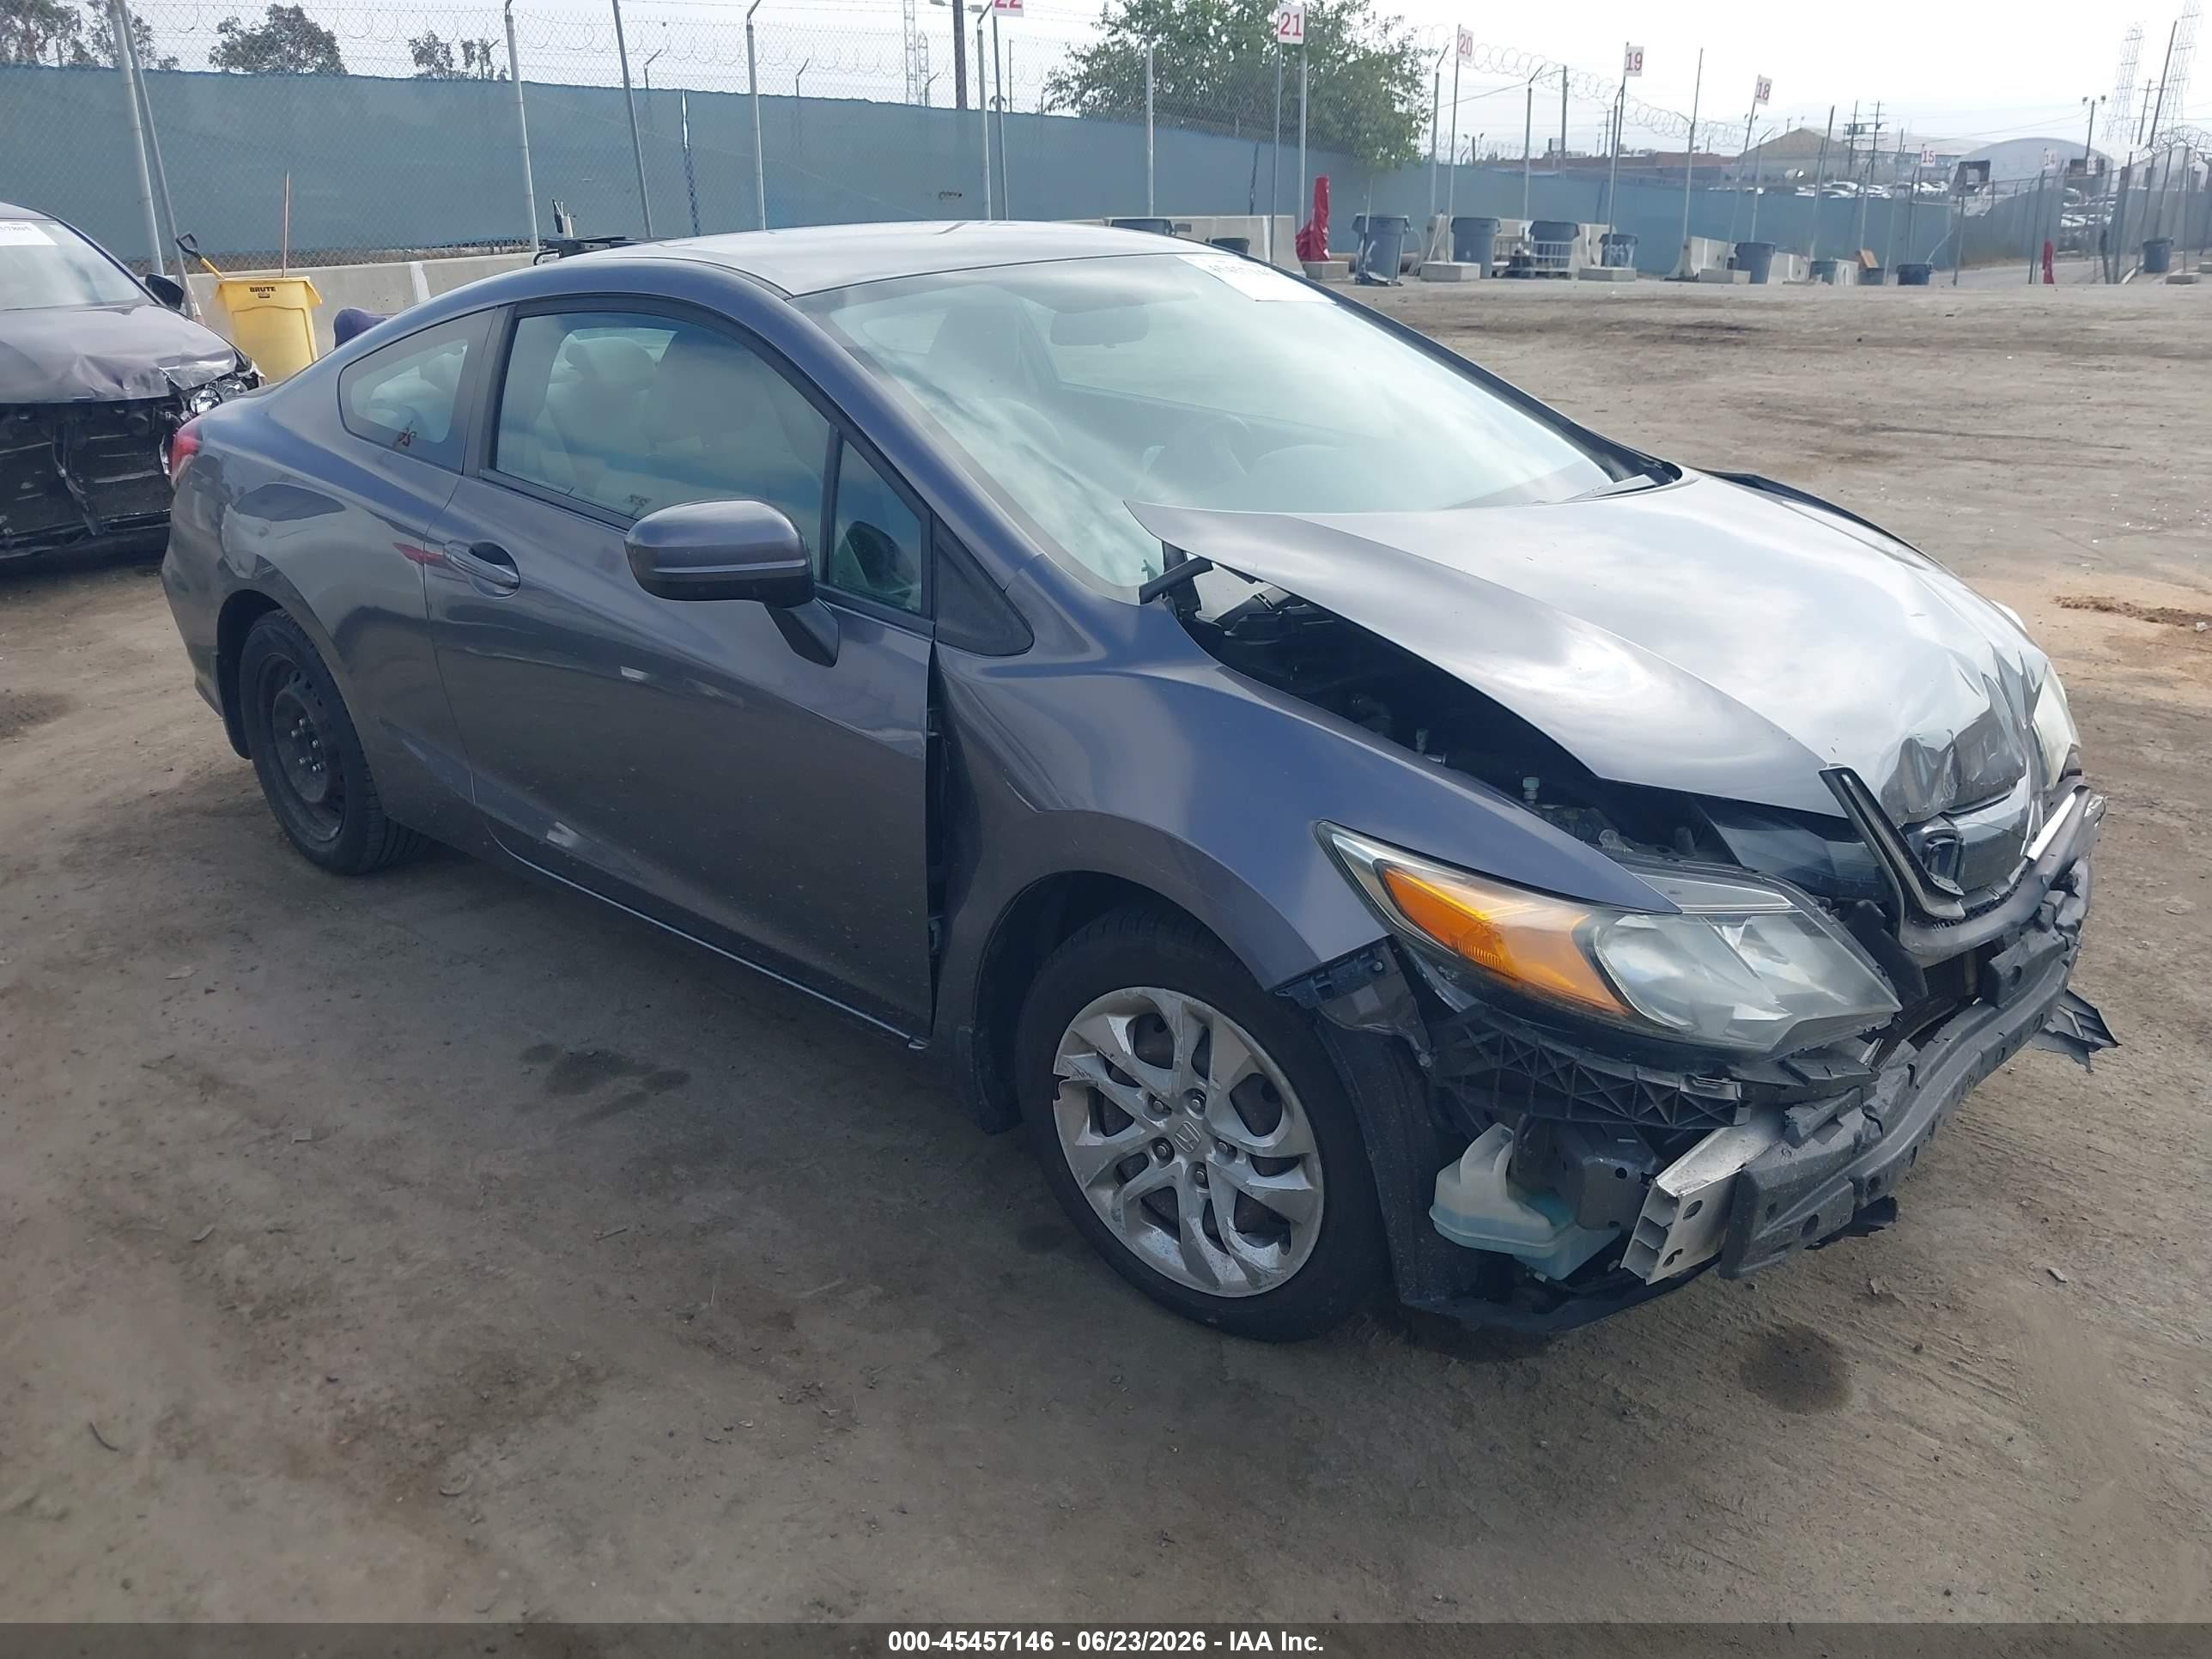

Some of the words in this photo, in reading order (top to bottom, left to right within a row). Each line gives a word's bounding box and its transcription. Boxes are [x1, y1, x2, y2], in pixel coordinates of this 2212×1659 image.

[1280, 12, 1302, 36] 21
[1459, 34, 1473, 56] 20
[1626, 52, 1643, 71] 19
[1756, 82, 1771, 100] 18
[1923, 150, 1935, 163] 15
